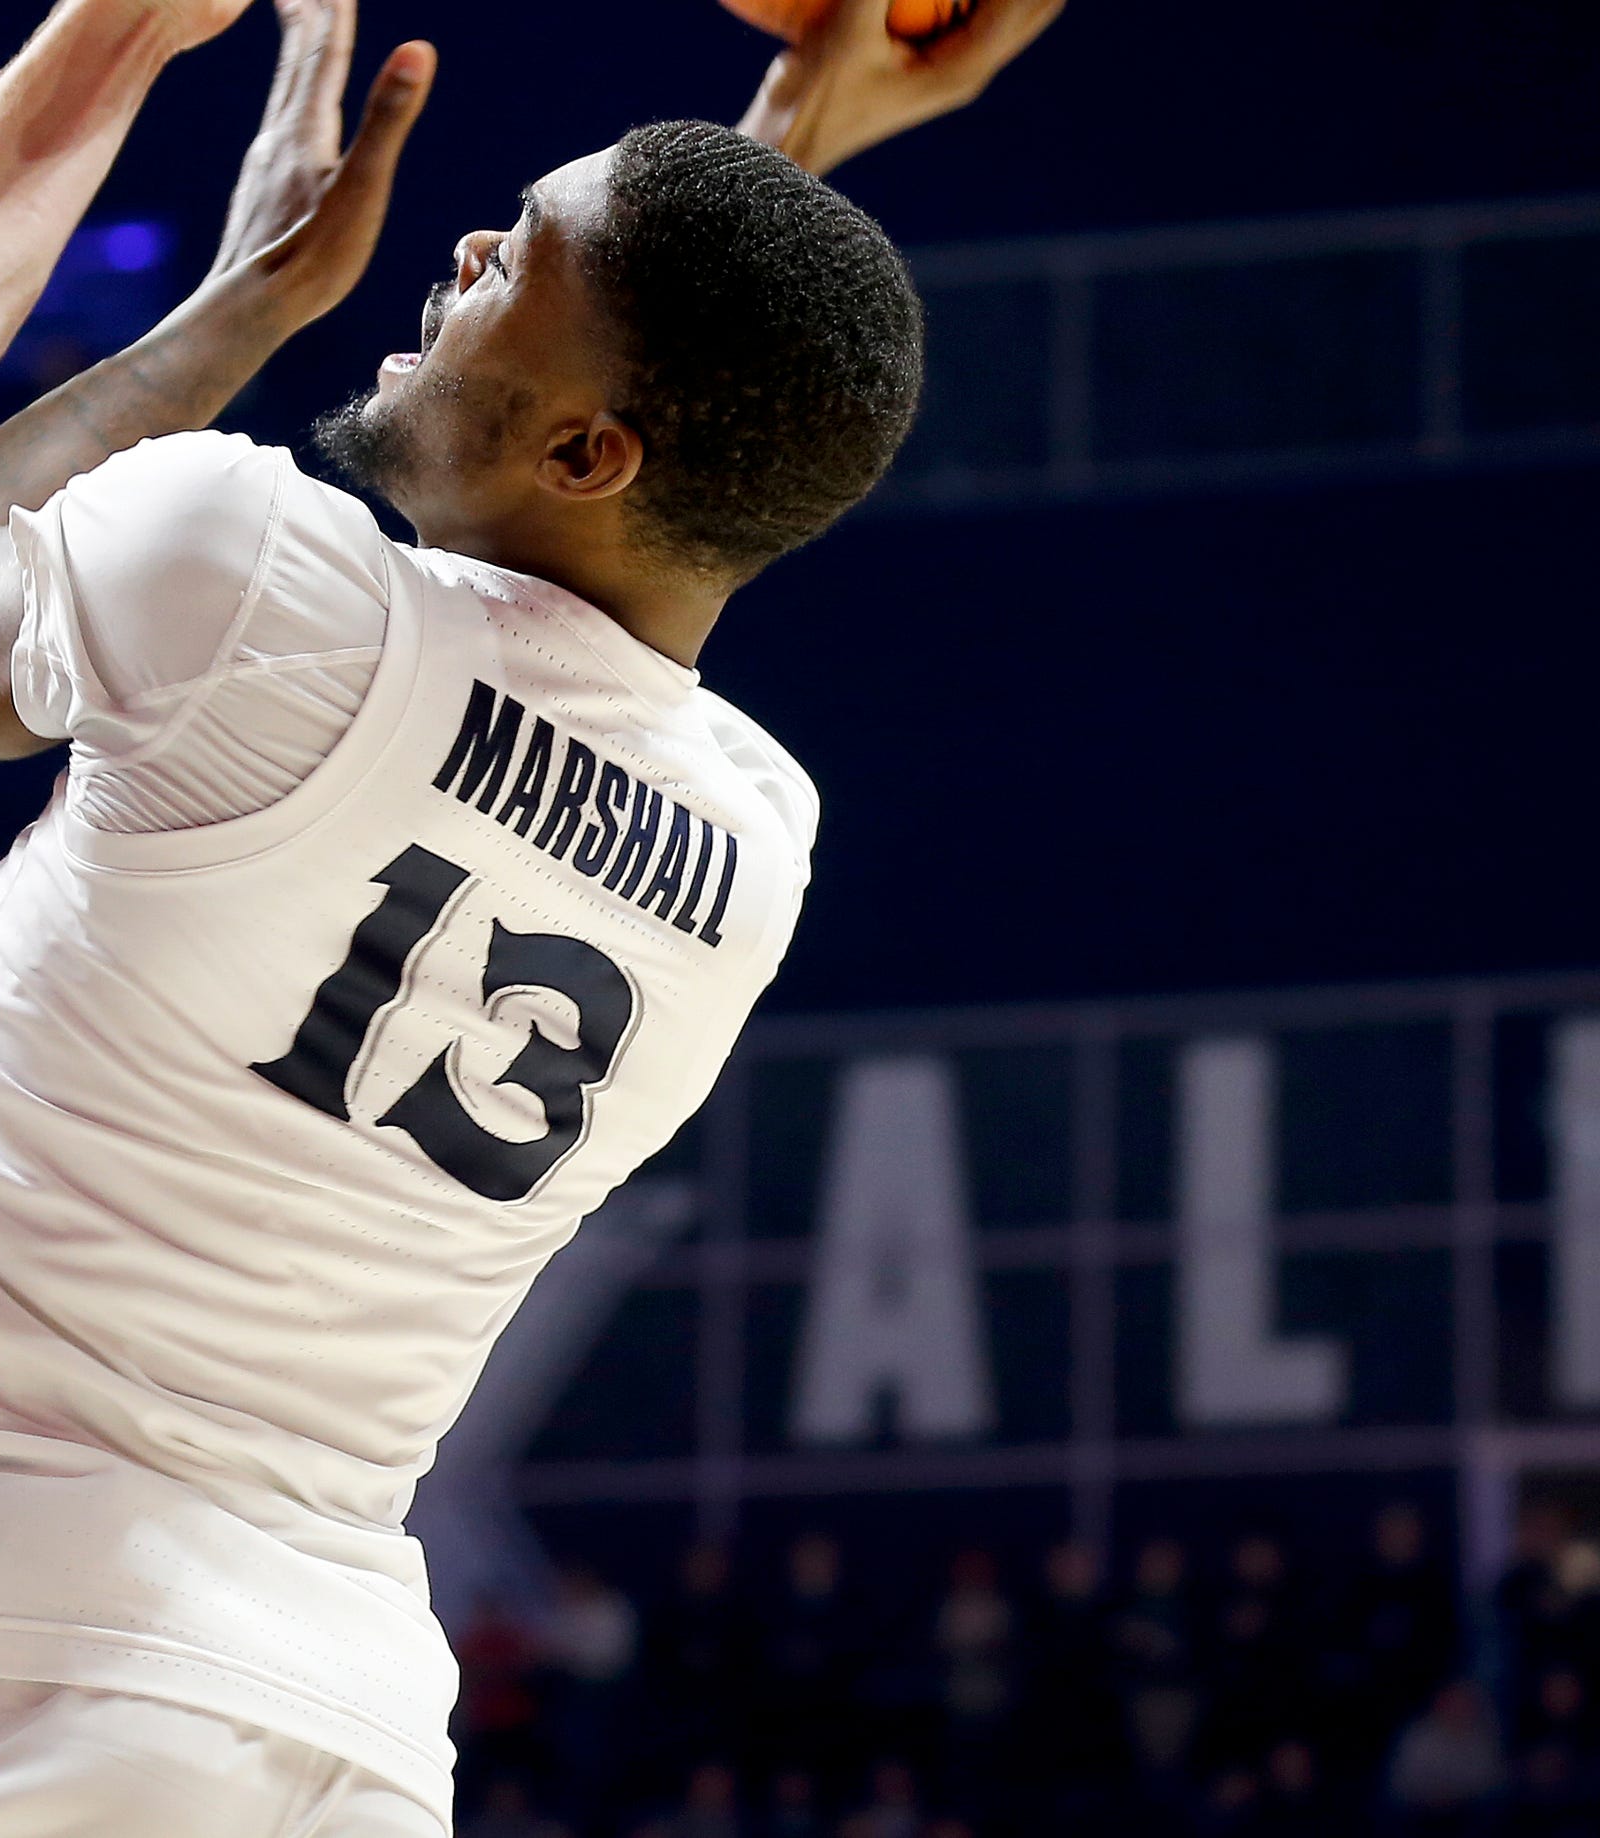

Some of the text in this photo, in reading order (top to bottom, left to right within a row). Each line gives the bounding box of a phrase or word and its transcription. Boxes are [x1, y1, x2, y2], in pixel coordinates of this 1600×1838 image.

[431, 678, 738, 948] MARSHALL
[247, 843, 644, 1204] 13
[785, 1012, 1600, 1440] AL
